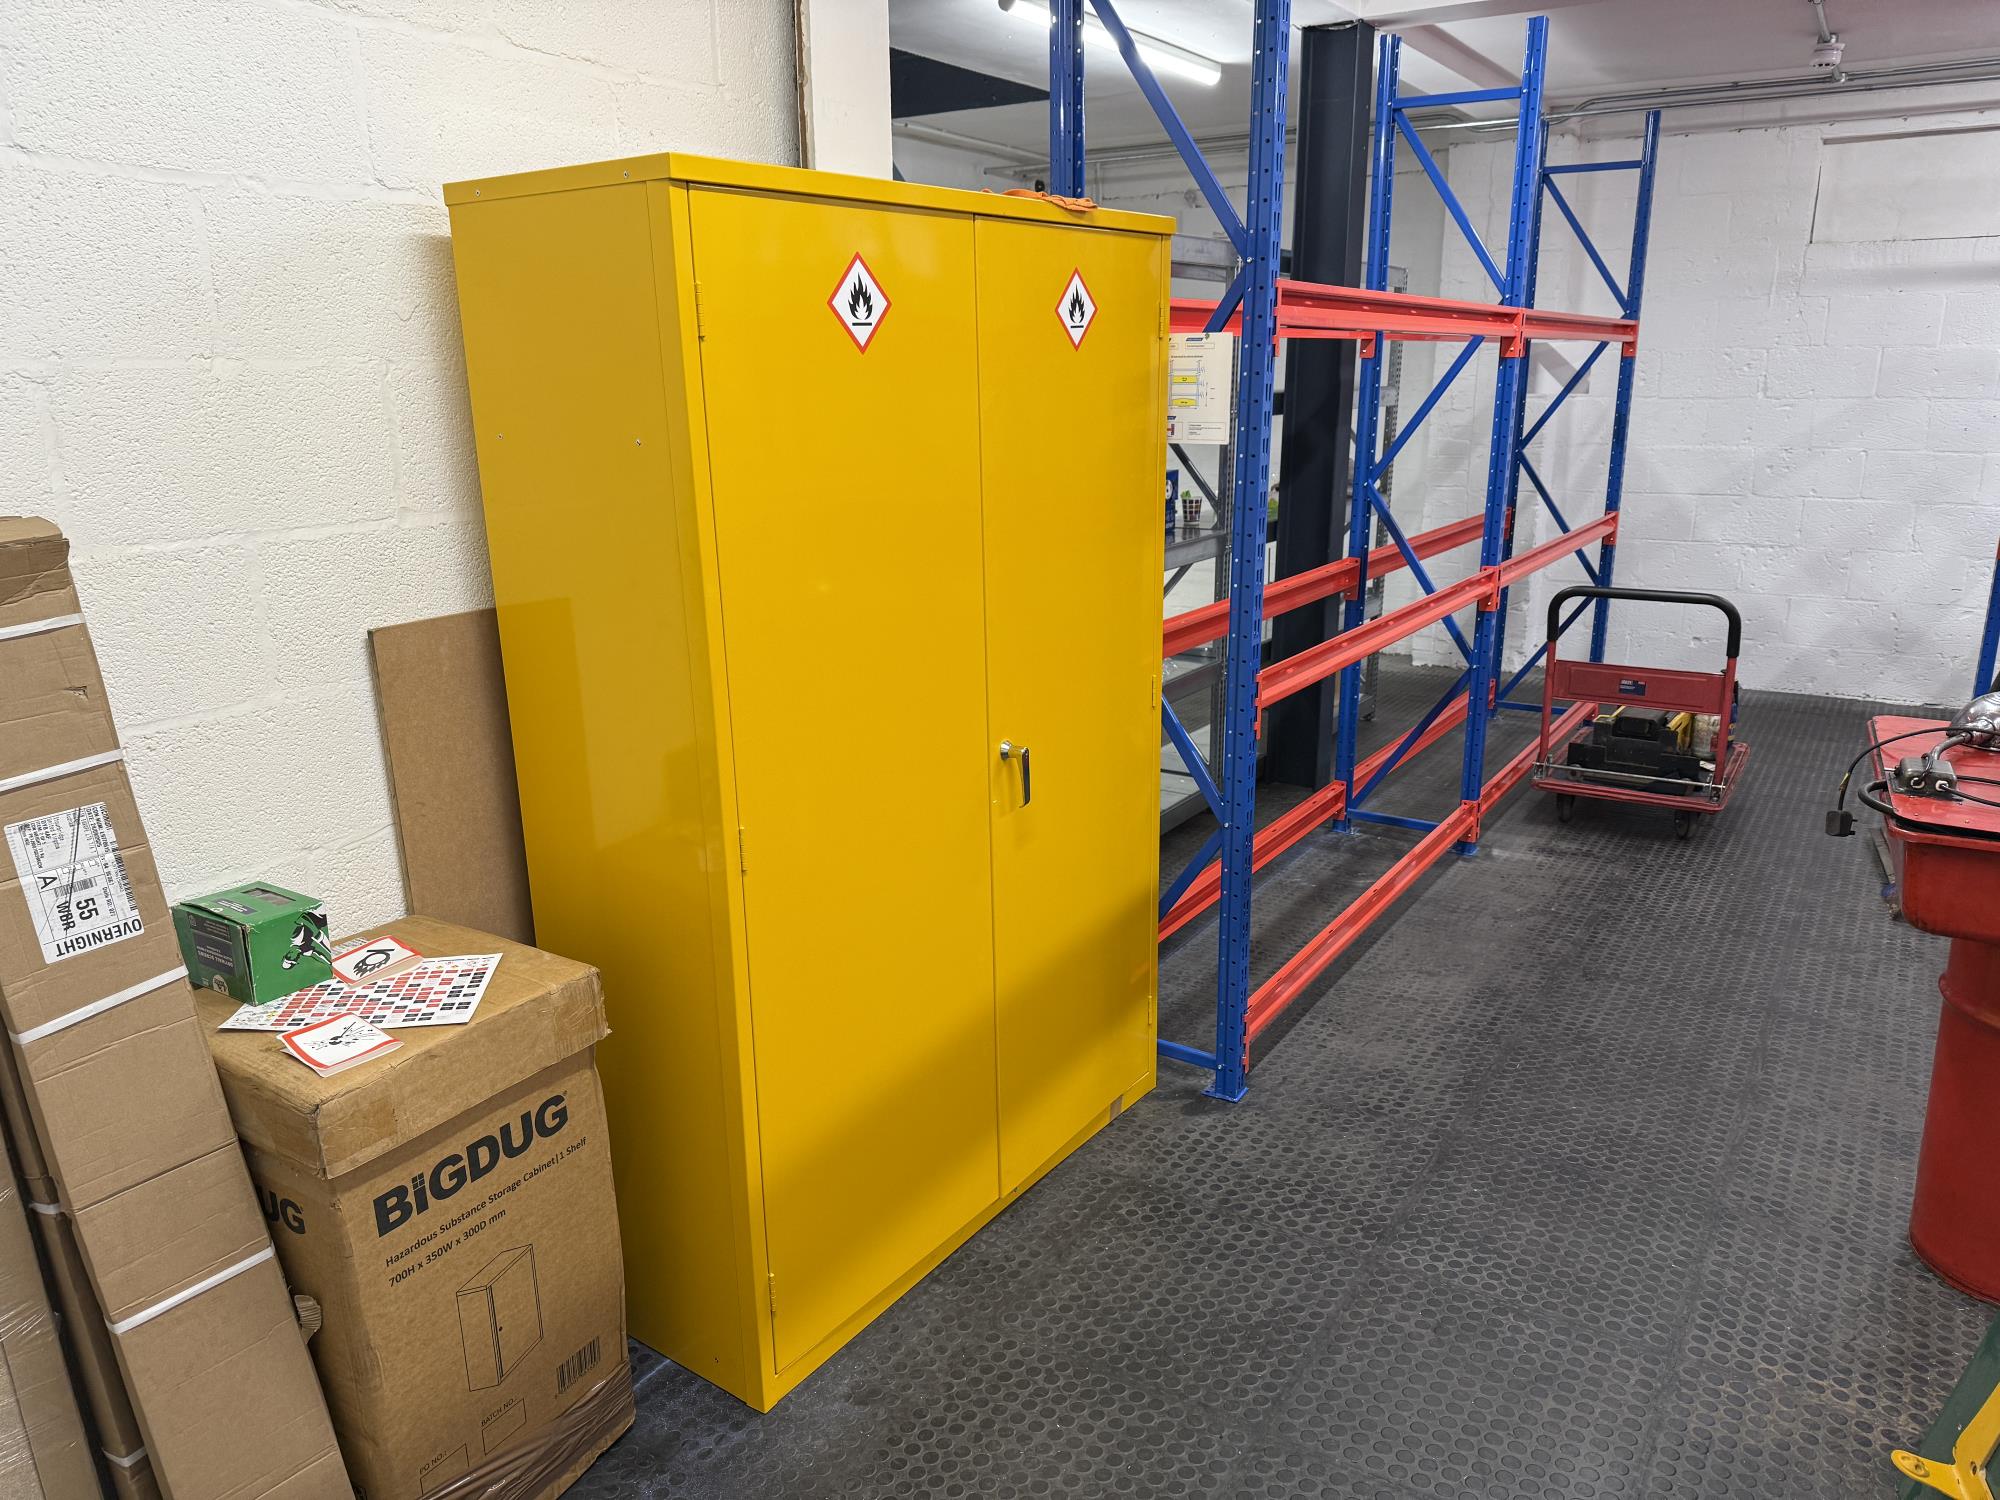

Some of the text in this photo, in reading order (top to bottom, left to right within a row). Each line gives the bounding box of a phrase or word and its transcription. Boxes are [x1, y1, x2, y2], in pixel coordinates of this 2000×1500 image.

[37, 873, 58, 889] A
[55, 900, 76, 931] WBR
[74, 896, 99, 921] 55
[56, 918, 143, 957] OVERNIGHT
[386, 1232, 438, 1267] Hazardous
[440, 1201, 486, 1234] Substance
[488, 1179, 521, 1204] Storage
[566, 1136, 586, 1156] Shelf
[389, 1209, 506, 1287] 700H x 350W x 300D mm
[481, 1408, 502, 1427] BATCH
[419, 1463, 430, 1474] PO
